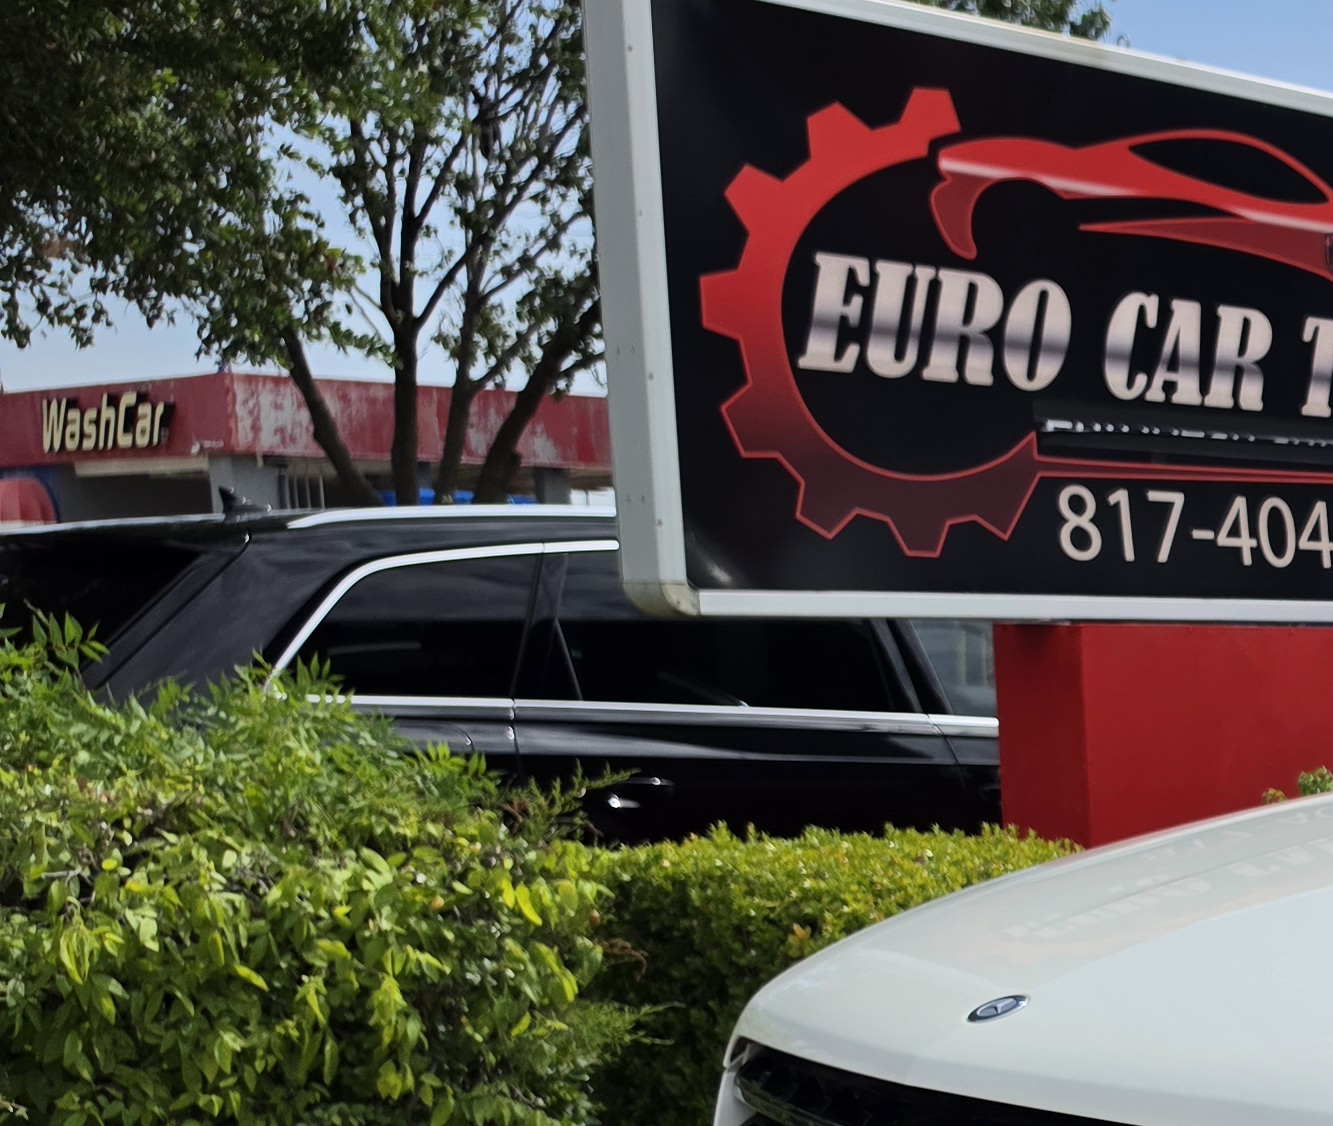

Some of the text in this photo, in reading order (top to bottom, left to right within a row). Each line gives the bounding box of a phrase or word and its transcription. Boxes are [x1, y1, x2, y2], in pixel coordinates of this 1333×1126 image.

[798, 251, 1072, 392] EURO
[1103, 289, 1274, 413] CAR
[42, 391, 164, 454] WashCar
